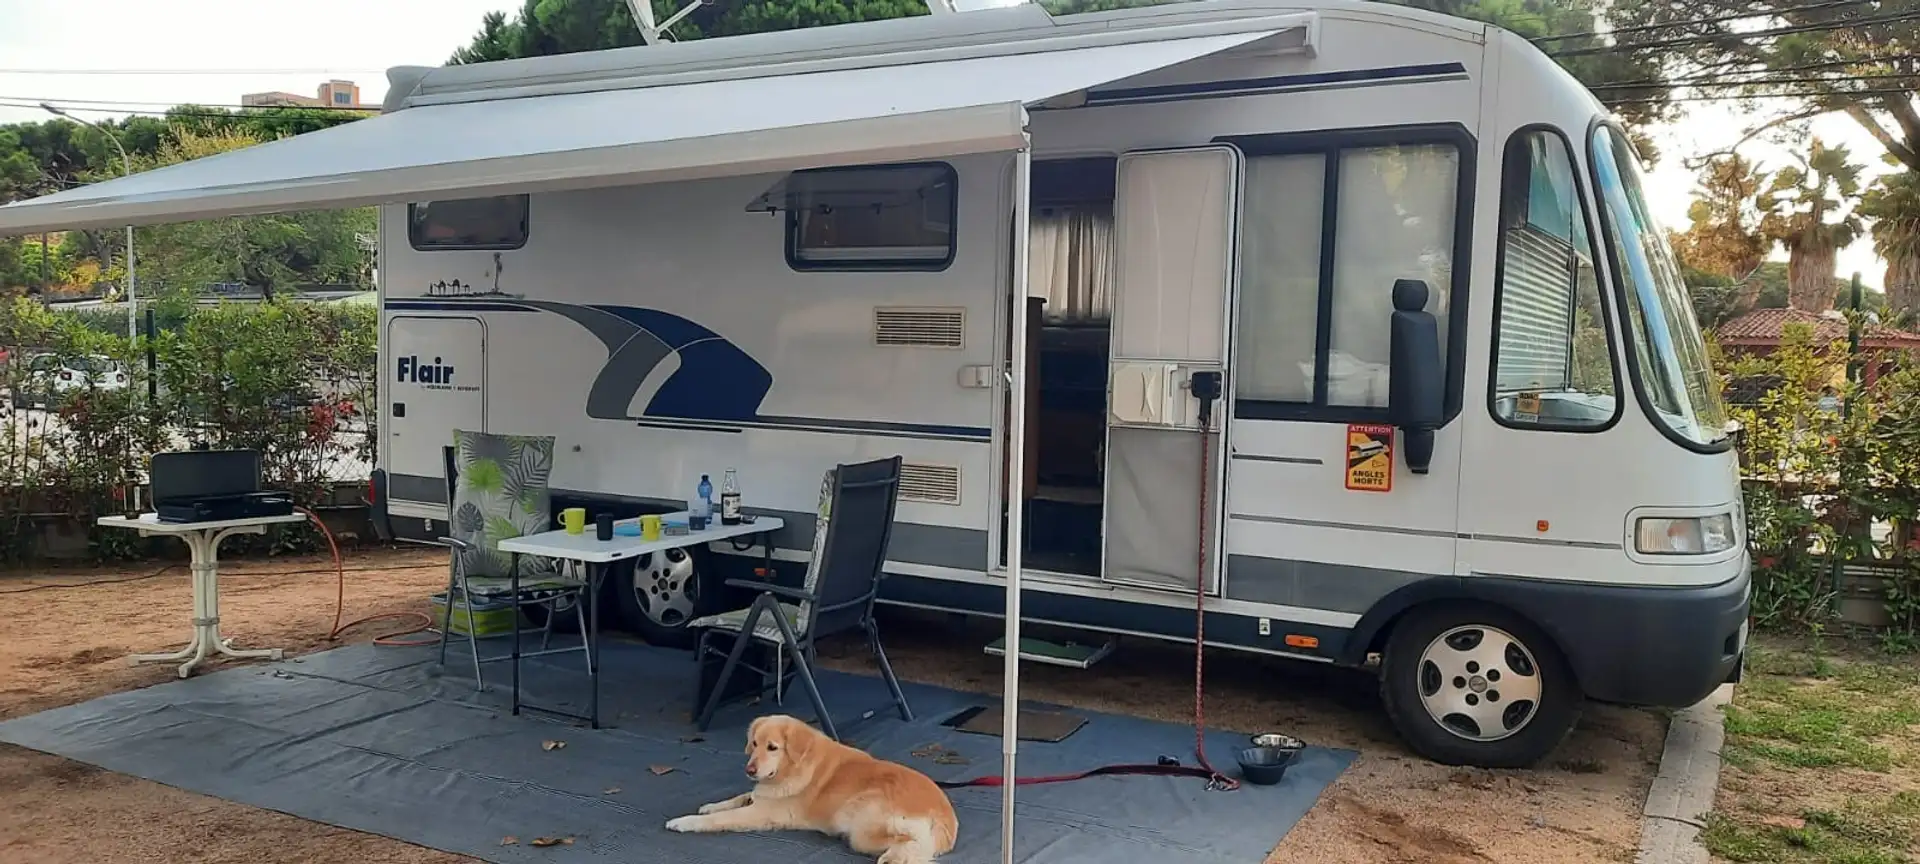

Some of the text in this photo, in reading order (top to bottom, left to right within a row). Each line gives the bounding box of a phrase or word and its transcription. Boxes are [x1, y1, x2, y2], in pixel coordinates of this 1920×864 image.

[397, 355, 455, 384] Flair
[1349, 425, 1391, 433] ATTENTION
[1352, 470, 1385, 478] ANGLES
